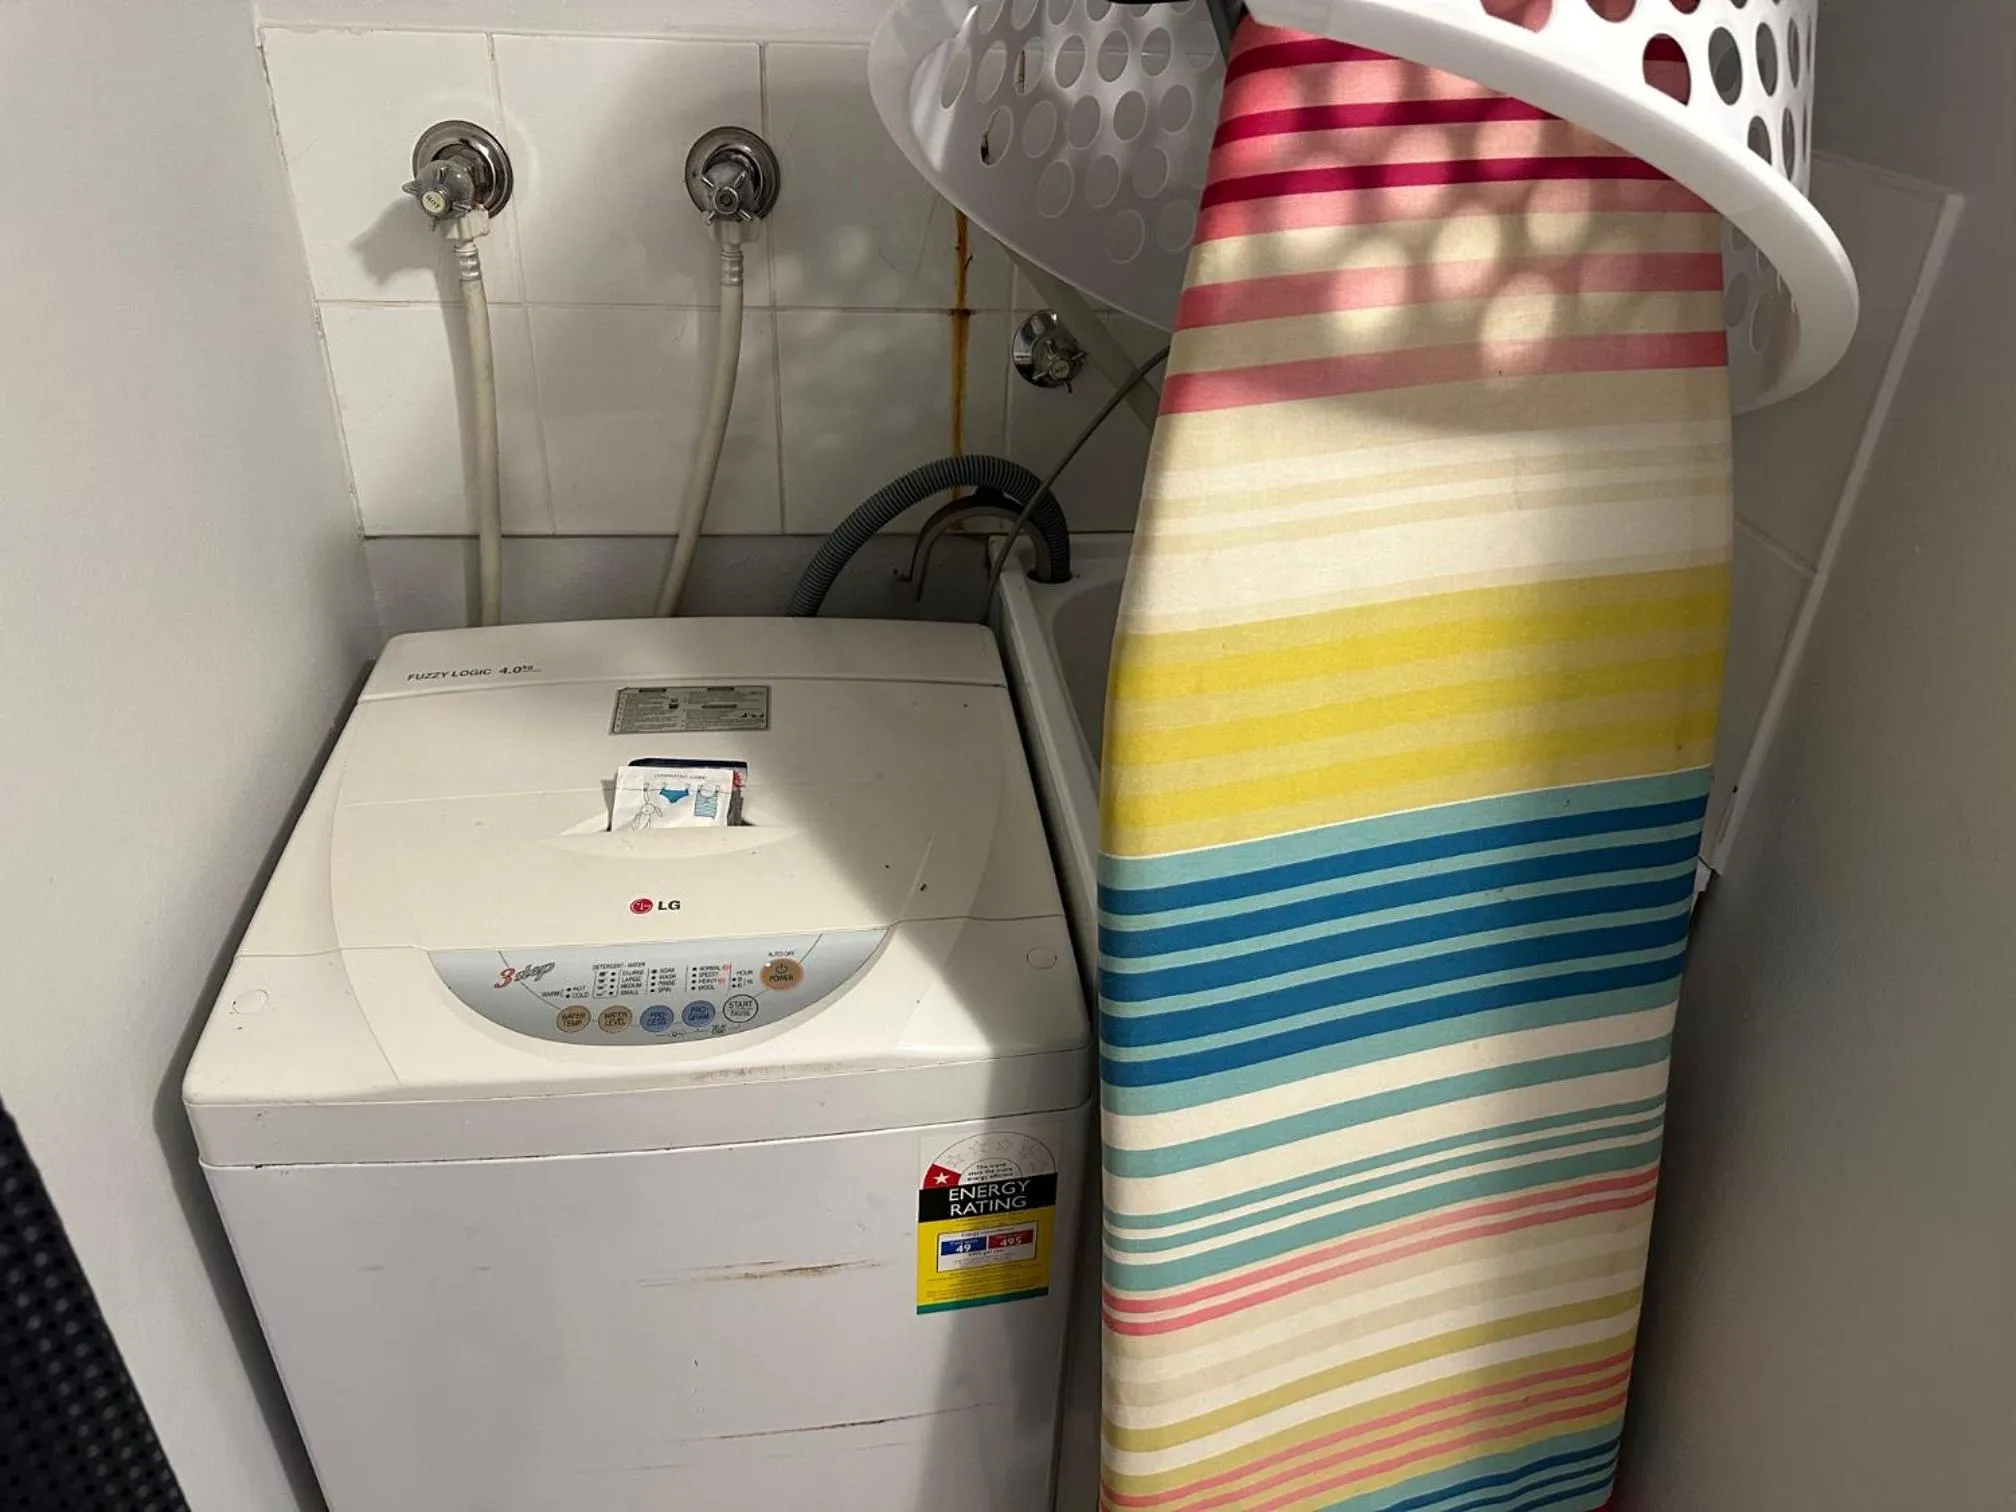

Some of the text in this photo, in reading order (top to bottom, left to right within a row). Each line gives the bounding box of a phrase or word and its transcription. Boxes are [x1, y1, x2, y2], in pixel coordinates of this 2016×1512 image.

[407, 671, 449, 680] FUZZY
[451, 669, 491, 677] LOGIC
[658, 900, 680, 910] LG
[729, 1001, 752, 1009] START
[949, 1180, 1030, 1201] ENERGY
[950, 1196, 1027, 1217] RATING
[956, 1244, 971, 1253] 49
